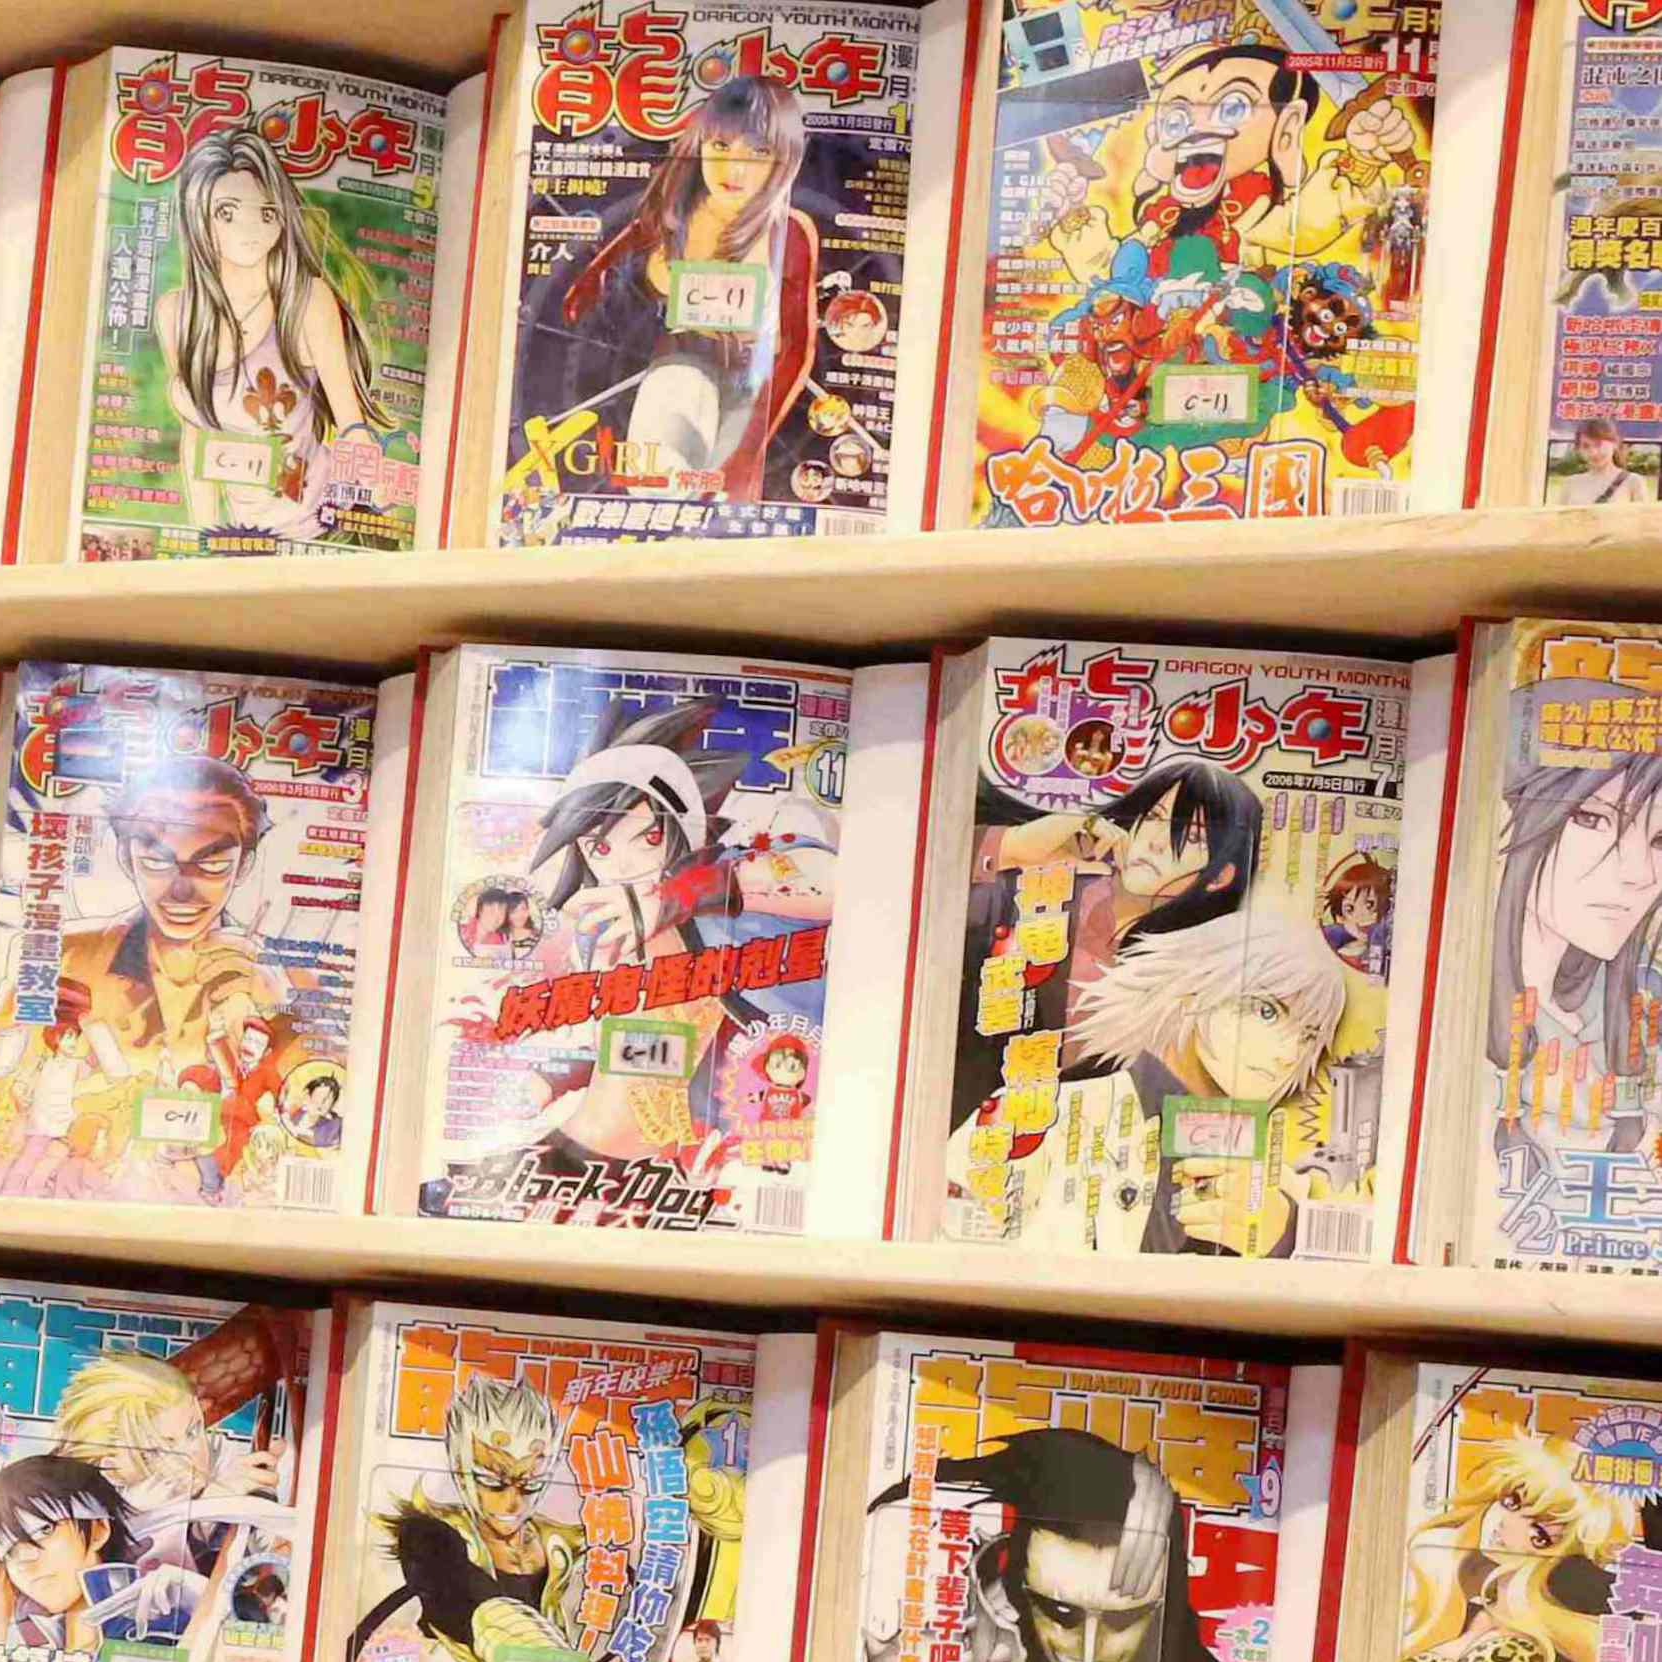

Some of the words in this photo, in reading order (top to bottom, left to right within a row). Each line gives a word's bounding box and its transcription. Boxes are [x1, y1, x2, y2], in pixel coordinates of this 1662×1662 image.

[692, 8, 775, 24] DRAGON
[781, 11, 846, 27] YOUTH
[257, 70, 328, 92] DRAGON
[335, 80, 391, 104] YOUTH
[1164, 658, 1252, 681] DRAGON
[1261, 664, 1327, 685] YOUTH
